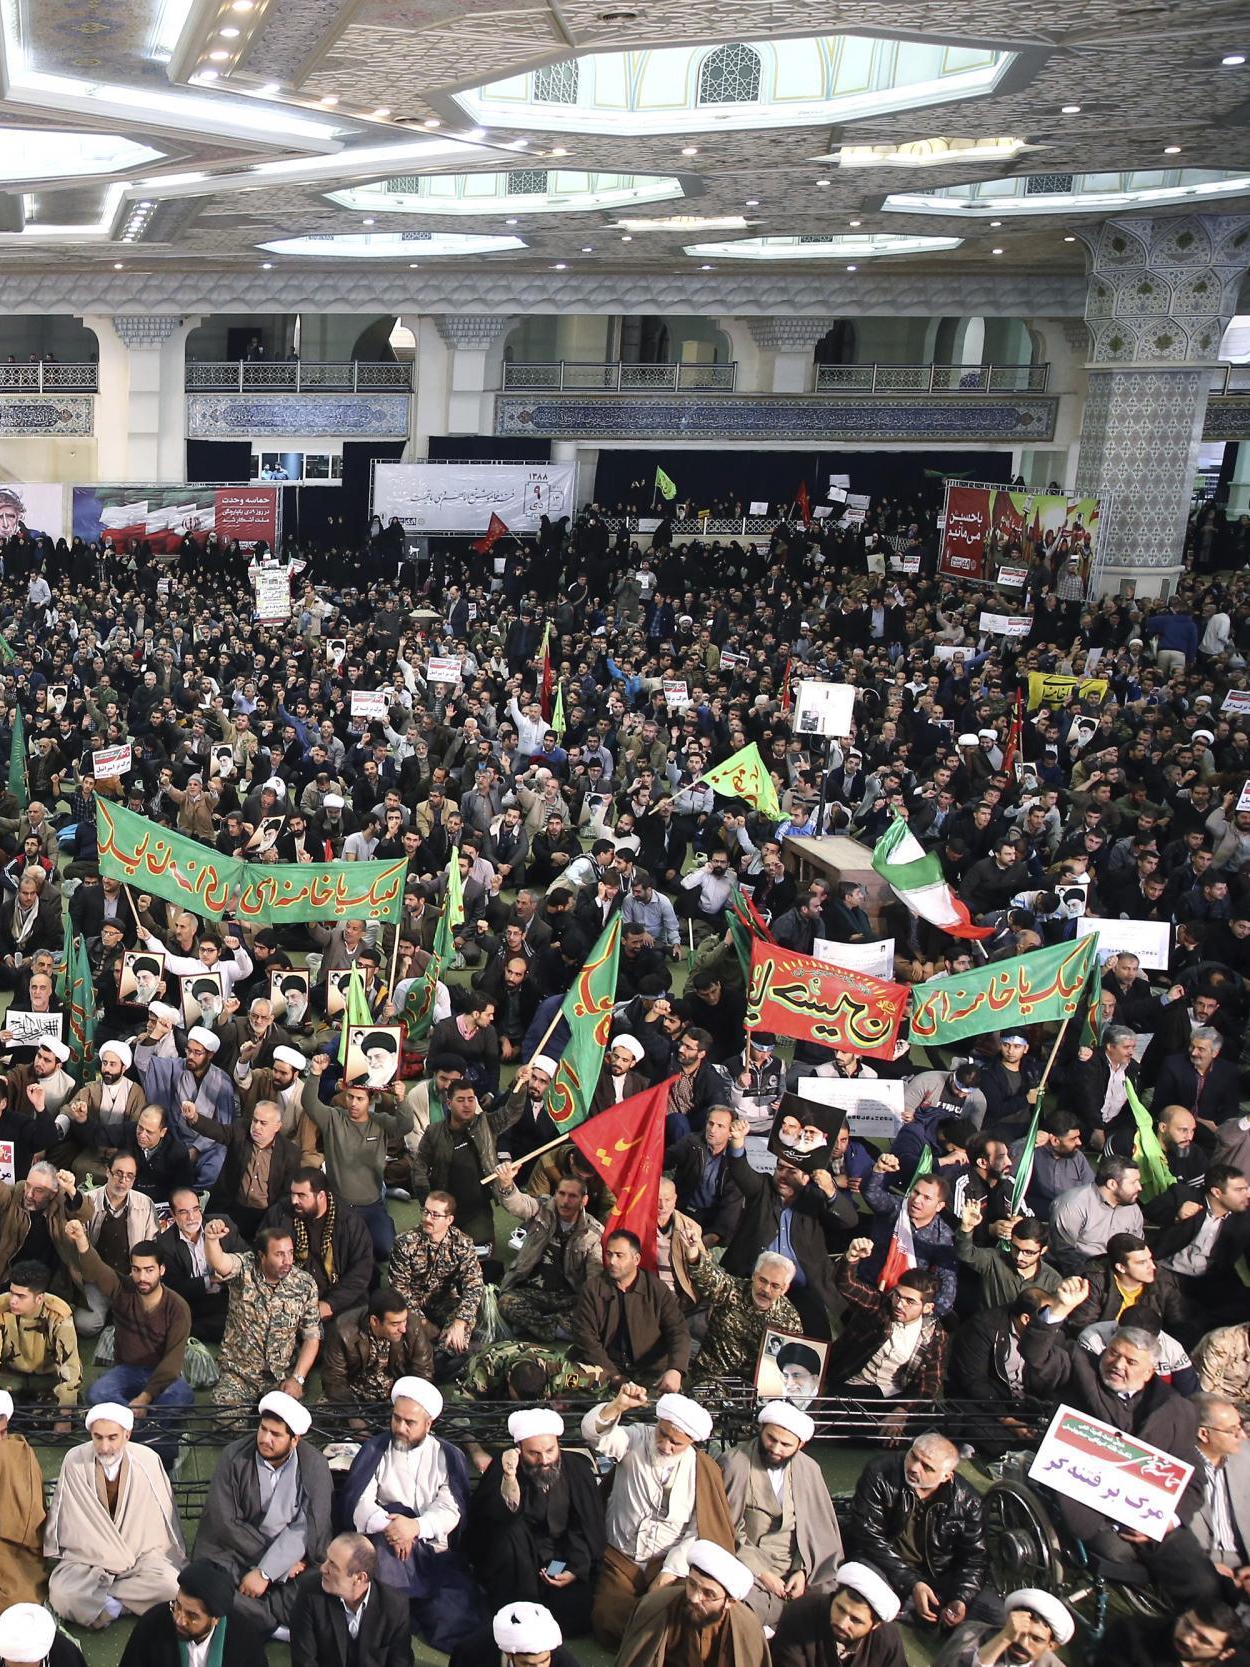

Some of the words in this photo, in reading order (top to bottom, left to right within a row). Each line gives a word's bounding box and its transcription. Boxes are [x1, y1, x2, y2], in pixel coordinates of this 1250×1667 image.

[222, 497, 243, 506] وحدت
[1043, 1457, 1070, 1472] گر
[1068, 1465, 1103, 1488] فتنه
[1100, 1487, 1120, 1503] بر
[1125, 1495, 1165, 1520] مرگ
